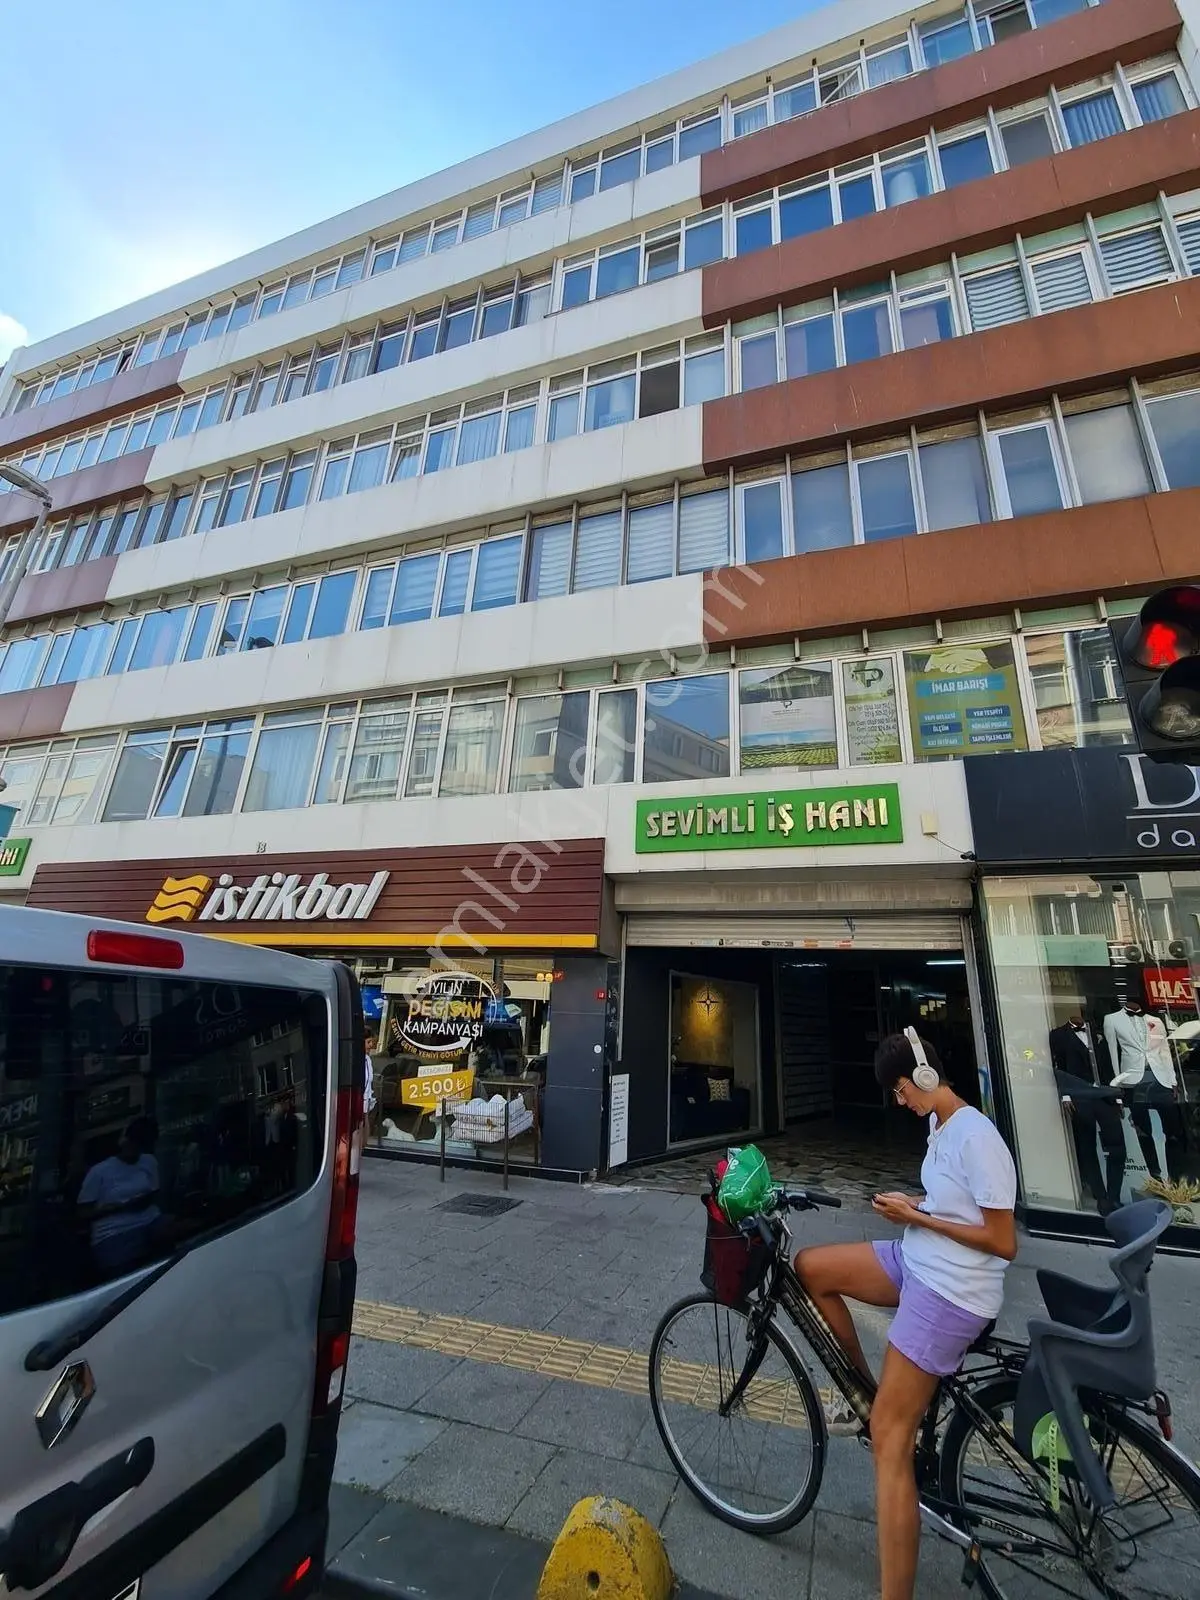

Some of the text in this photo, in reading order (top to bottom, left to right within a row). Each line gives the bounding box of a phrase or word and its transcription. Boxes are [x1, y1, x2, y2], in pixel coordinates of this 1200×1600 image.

[931, 678, 988, 694] İMAR BARIŞI
[646, 798, 889, 839] SEVİMLİ İŞ HANI
[0, 848, 20, 866] NI
[199, 871, 392, 921] istikbal
[408, 1078, 454, 1099] 2.500
